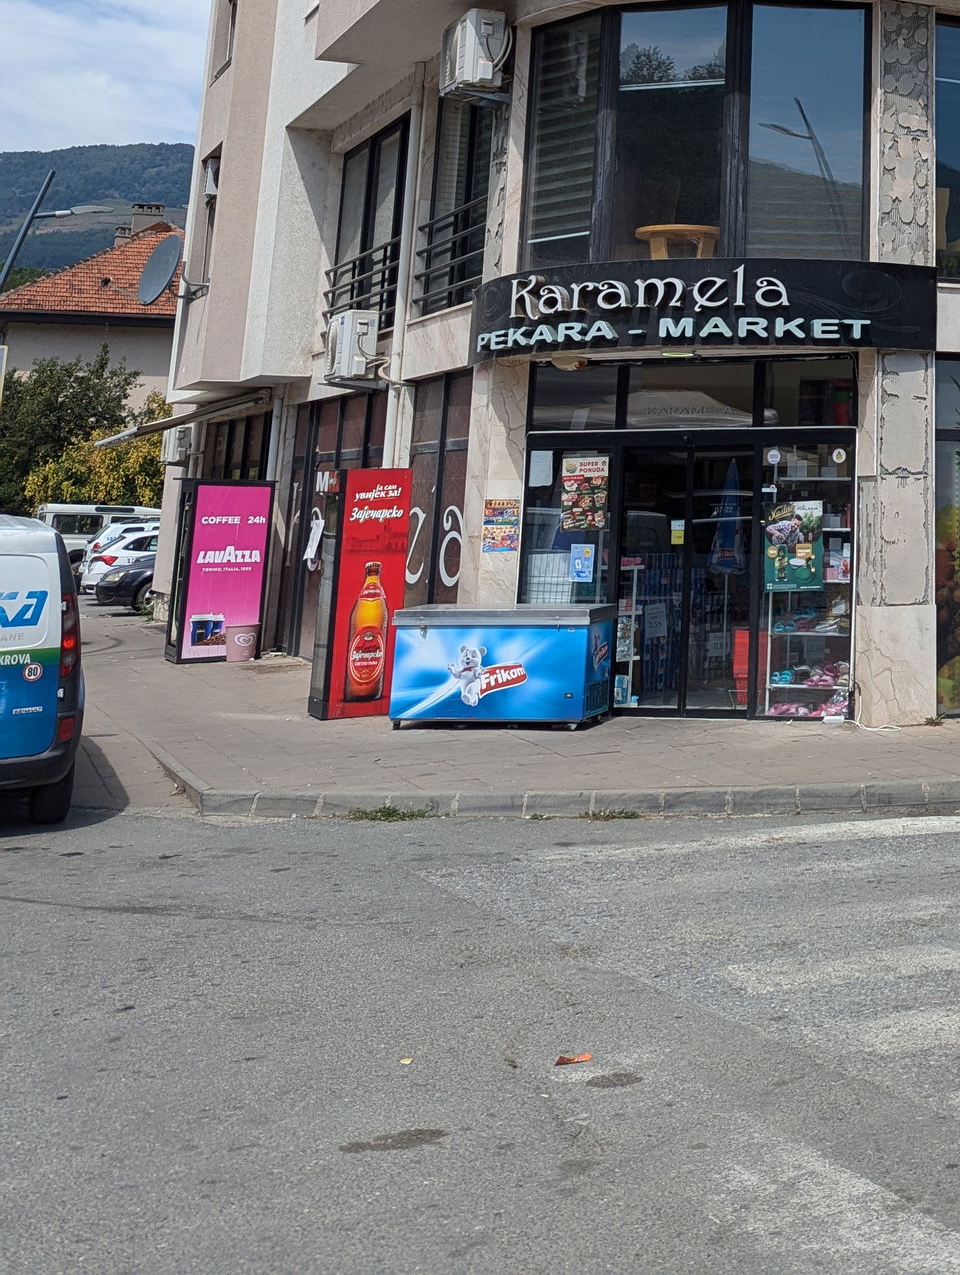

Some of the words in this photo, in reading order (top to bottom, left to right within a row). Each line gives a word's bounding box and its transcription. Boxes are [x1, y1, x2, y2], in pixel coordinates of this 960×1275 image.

[509, 263, 791, 320] Karamela
[476, 319, 619, 353] PEKARA
[658, 317, 872, 340] MARKET
[647, 406, 733, 416] KARAMEA
[201, 516, 241, 524] COFFEE
[248, 516, 266, 524] 24h
[196, 545, 261, 564] LAVAZZA
[27, 667, 38, 677] 80
[481, 666, 526, 689] Frikom
